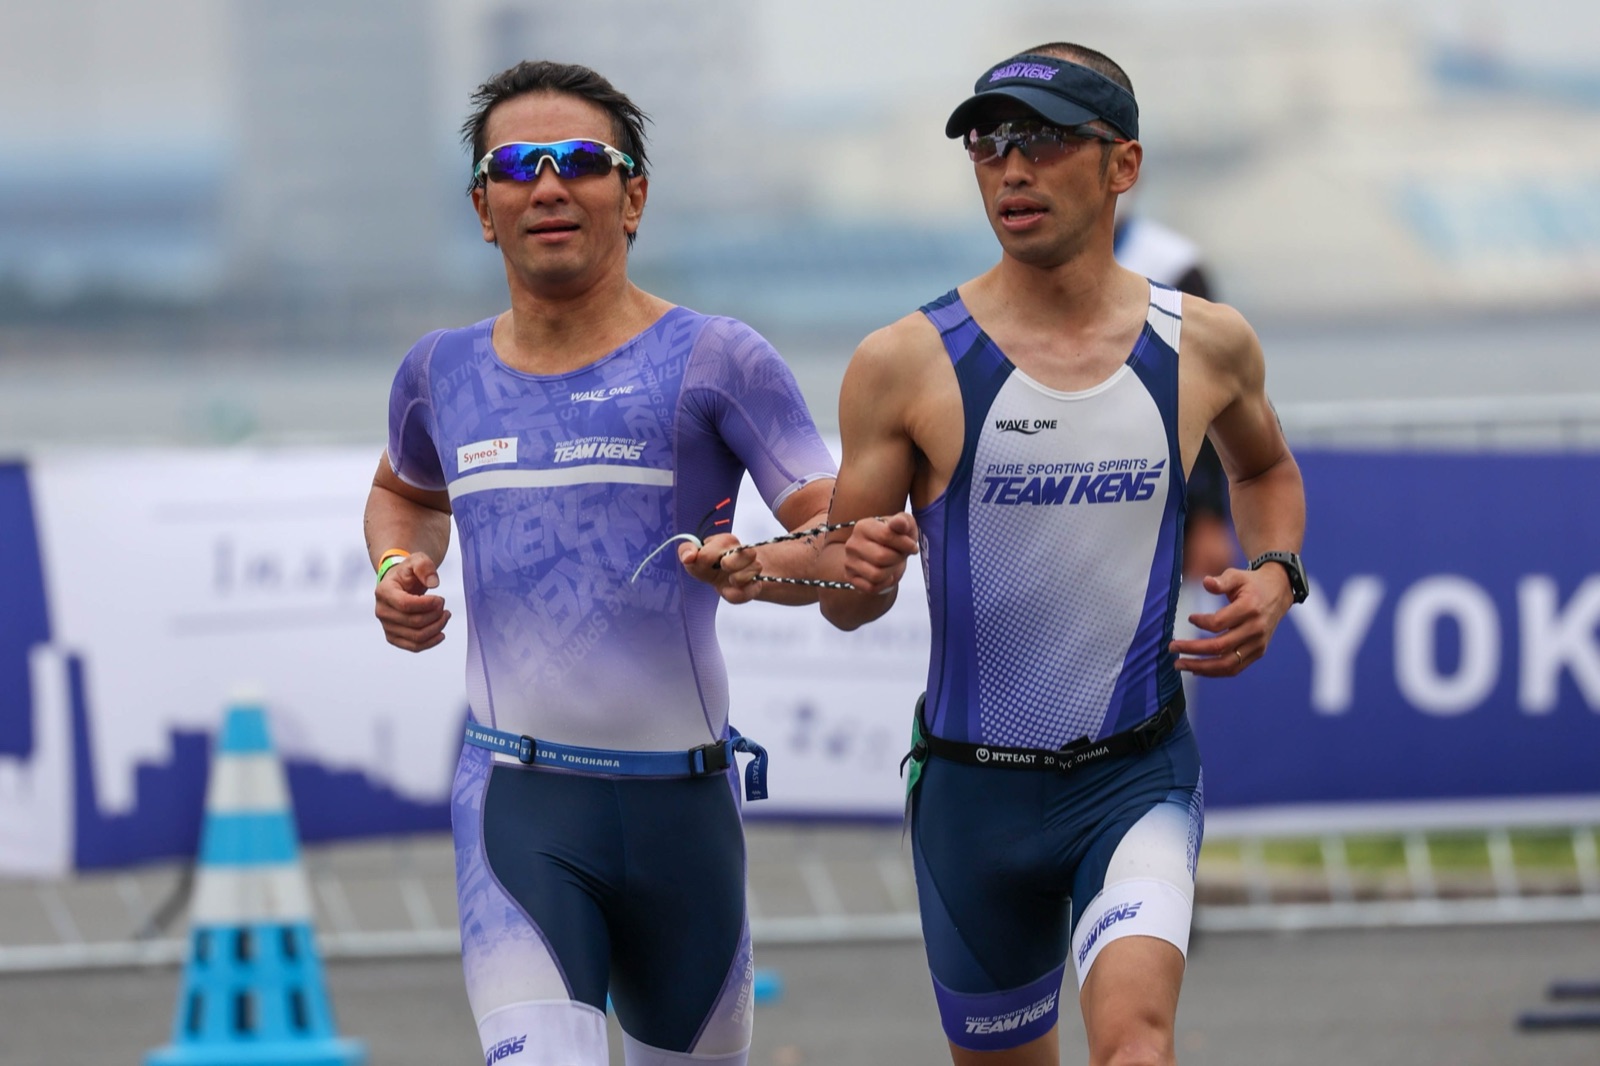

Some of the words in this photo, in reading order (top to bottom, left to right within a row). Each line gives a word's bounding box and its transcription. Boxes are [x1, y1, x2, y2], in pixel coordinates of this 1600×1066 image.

[570, 389, 606, 402] WAVE
[608, 385, 634, 396] ONE
[995, 419, 1029, 432] WAVE
[1034, 420, 1058, 430] ONE
[553, 443, 598, 463] TEAM
[595, 441, 647, 461] KENS
[555, 440, 576, 449] PURE
[574, 436, 609, 446] SPORTING
[610, 437, 636, 446] SPIRITS
[463, 449, 498, 464] Syneos
[986, 464, 1024, 475] PURE
[1027, 461, 1094, 475] SPORTING
[1098, 459, 1148, 472] SPIRITS
[981, 475, 1074, 506] TEAM
[1069, 463, 1163, 505] KENS
[475, 731, 506, 747] WORLD
[509, 740, 557, 760] TRTLON
[561, 753, 620, 768] YOKOHAMA
[1098, 901, 1142, 936] KENS
[965, 1012, 1020, 1034] TEAM
[1020, 989, 1058, 1027] KENS
[965, 1015, 990, 1023] PURE
[992, 1005, 1031, 1021] SPORTING
[493, 1034, 527, 1064] KENS
